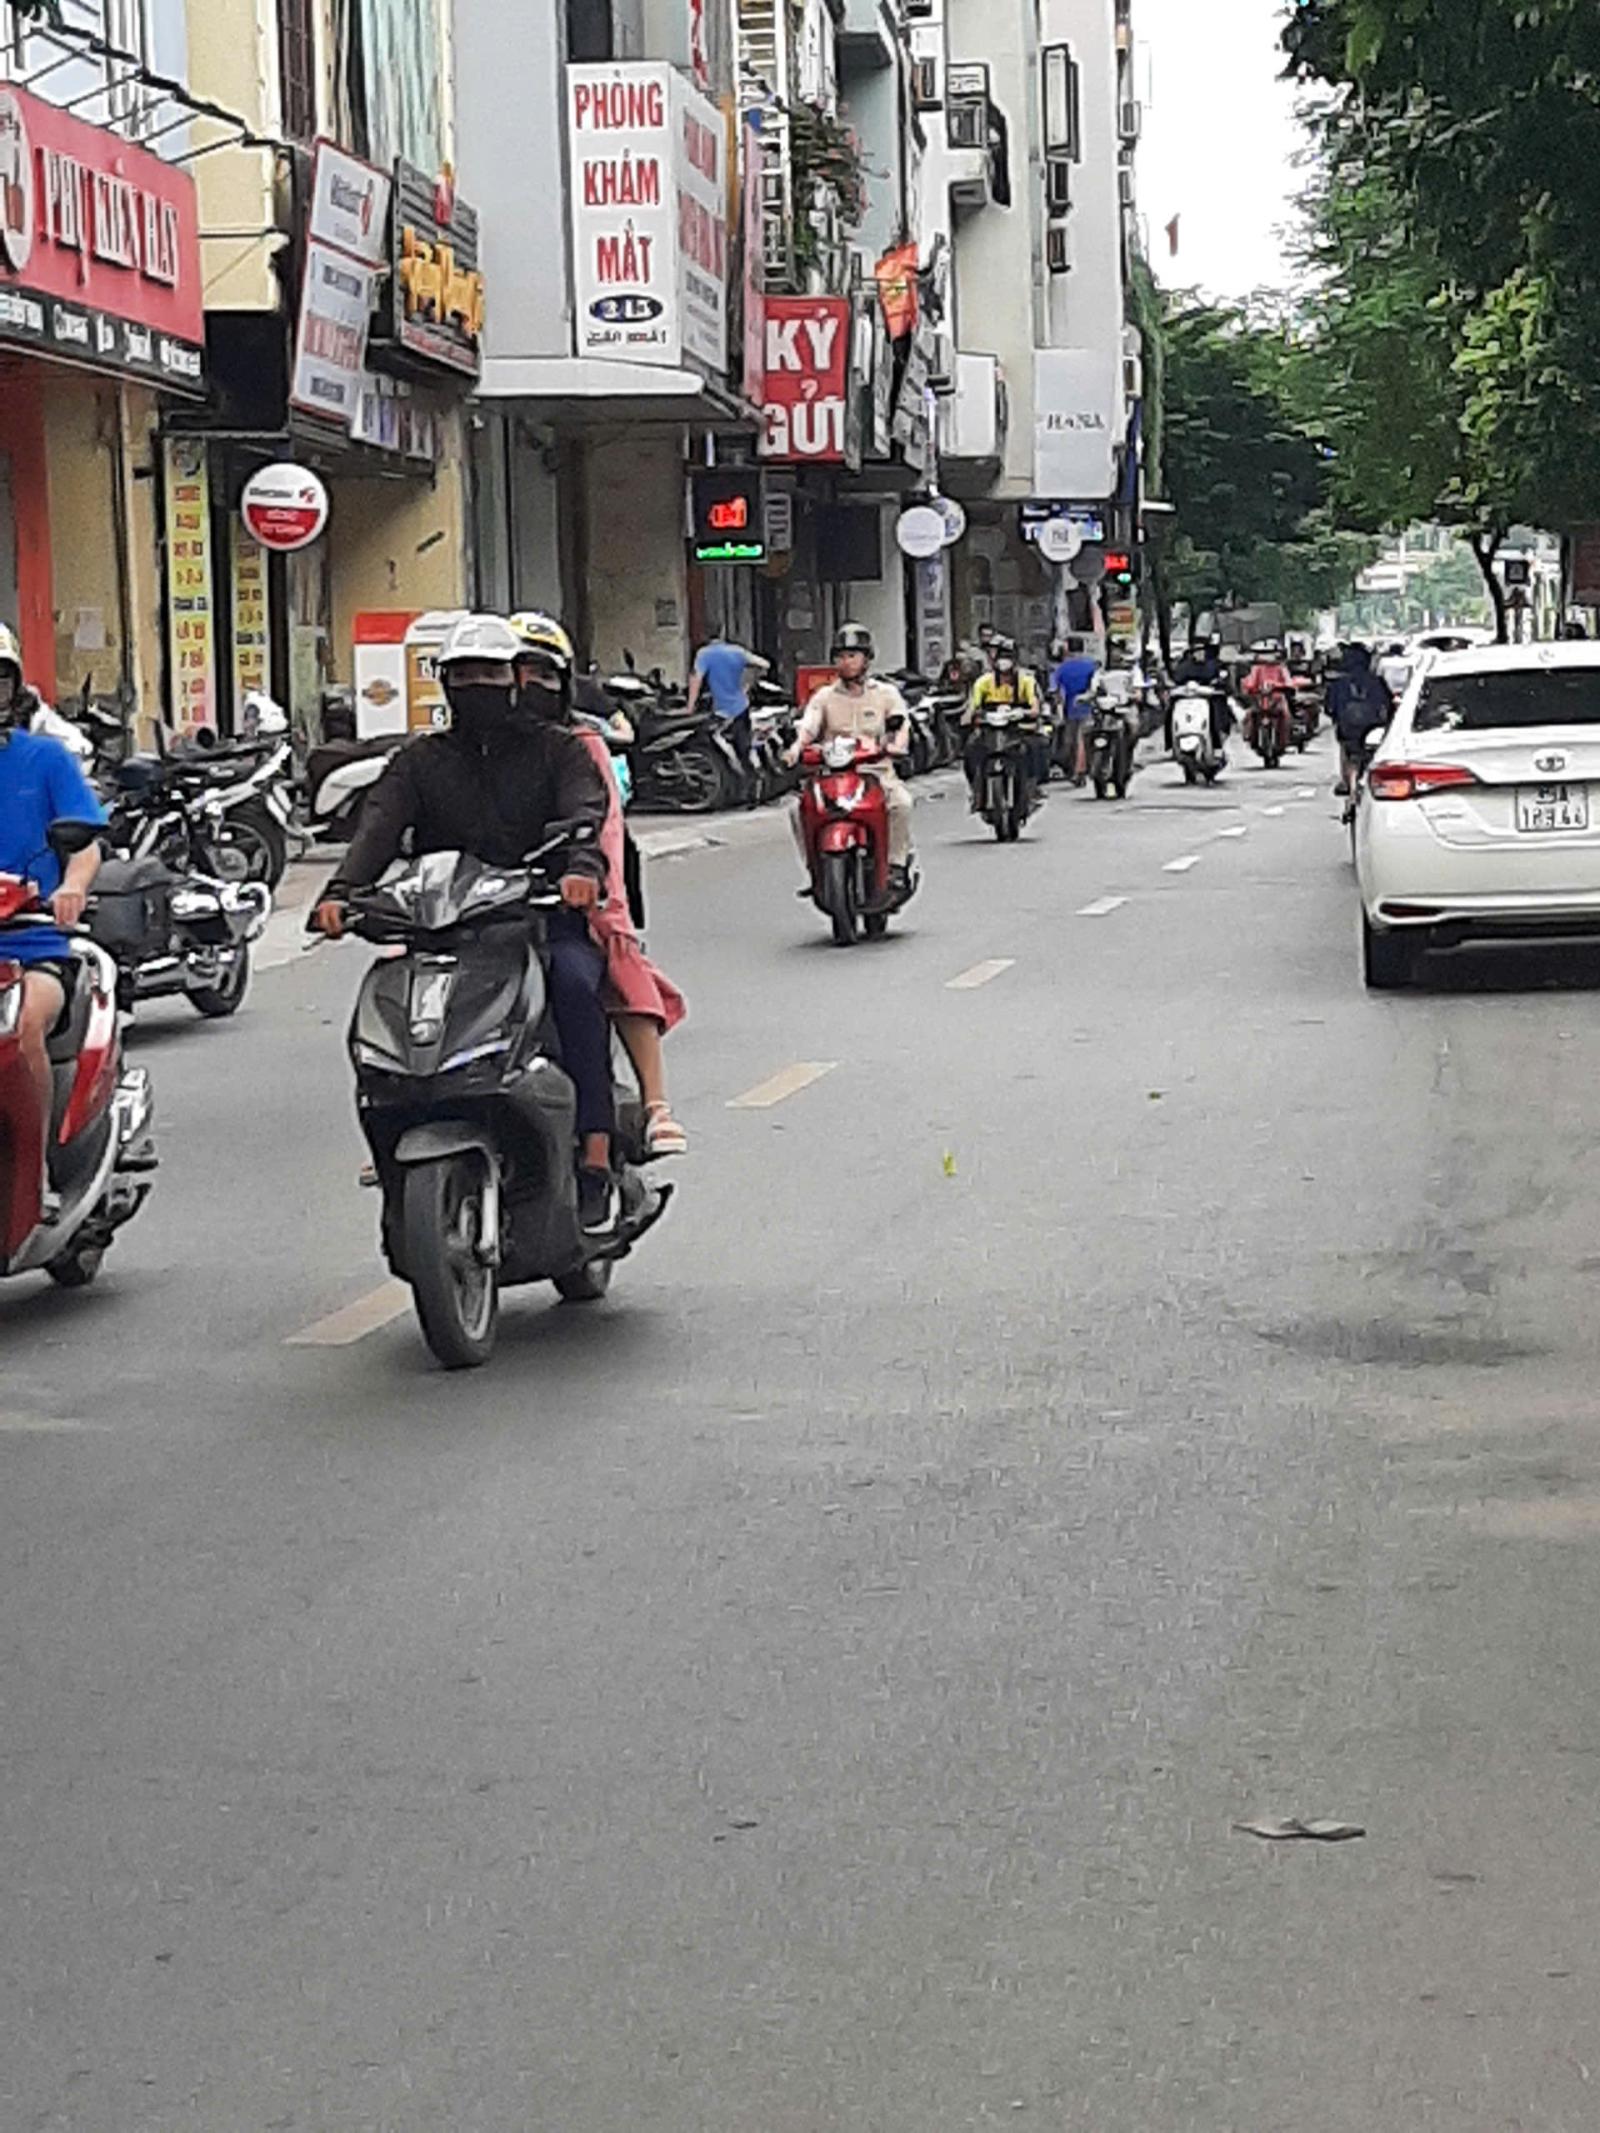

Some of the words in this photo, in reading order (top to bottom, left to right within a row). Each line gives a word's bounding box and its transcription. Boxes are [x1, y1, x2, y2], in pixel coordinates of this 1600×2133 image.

[574, 69, 664, 130] PHÒNG
[583, 147, 660, 206] KHÁM
[596, 218, 653, 284] MẮT
